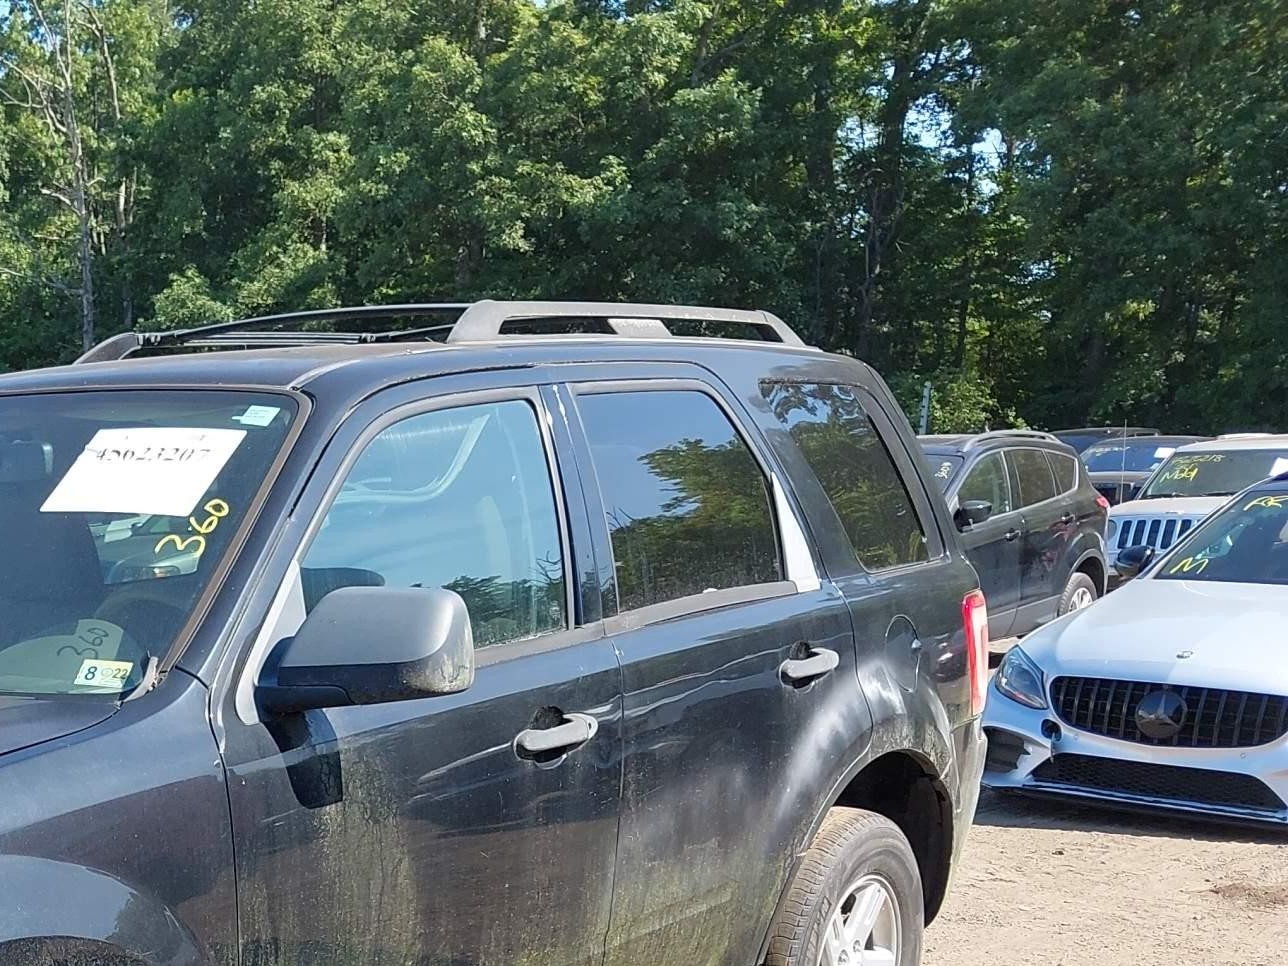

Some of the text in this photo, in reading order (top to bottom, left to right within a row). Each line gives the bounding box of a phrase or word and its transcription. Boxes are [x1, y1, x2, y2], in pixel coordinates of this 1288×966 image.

[154, 498, 230, 555] 360
[84, 666, 128, 681] 8 22
